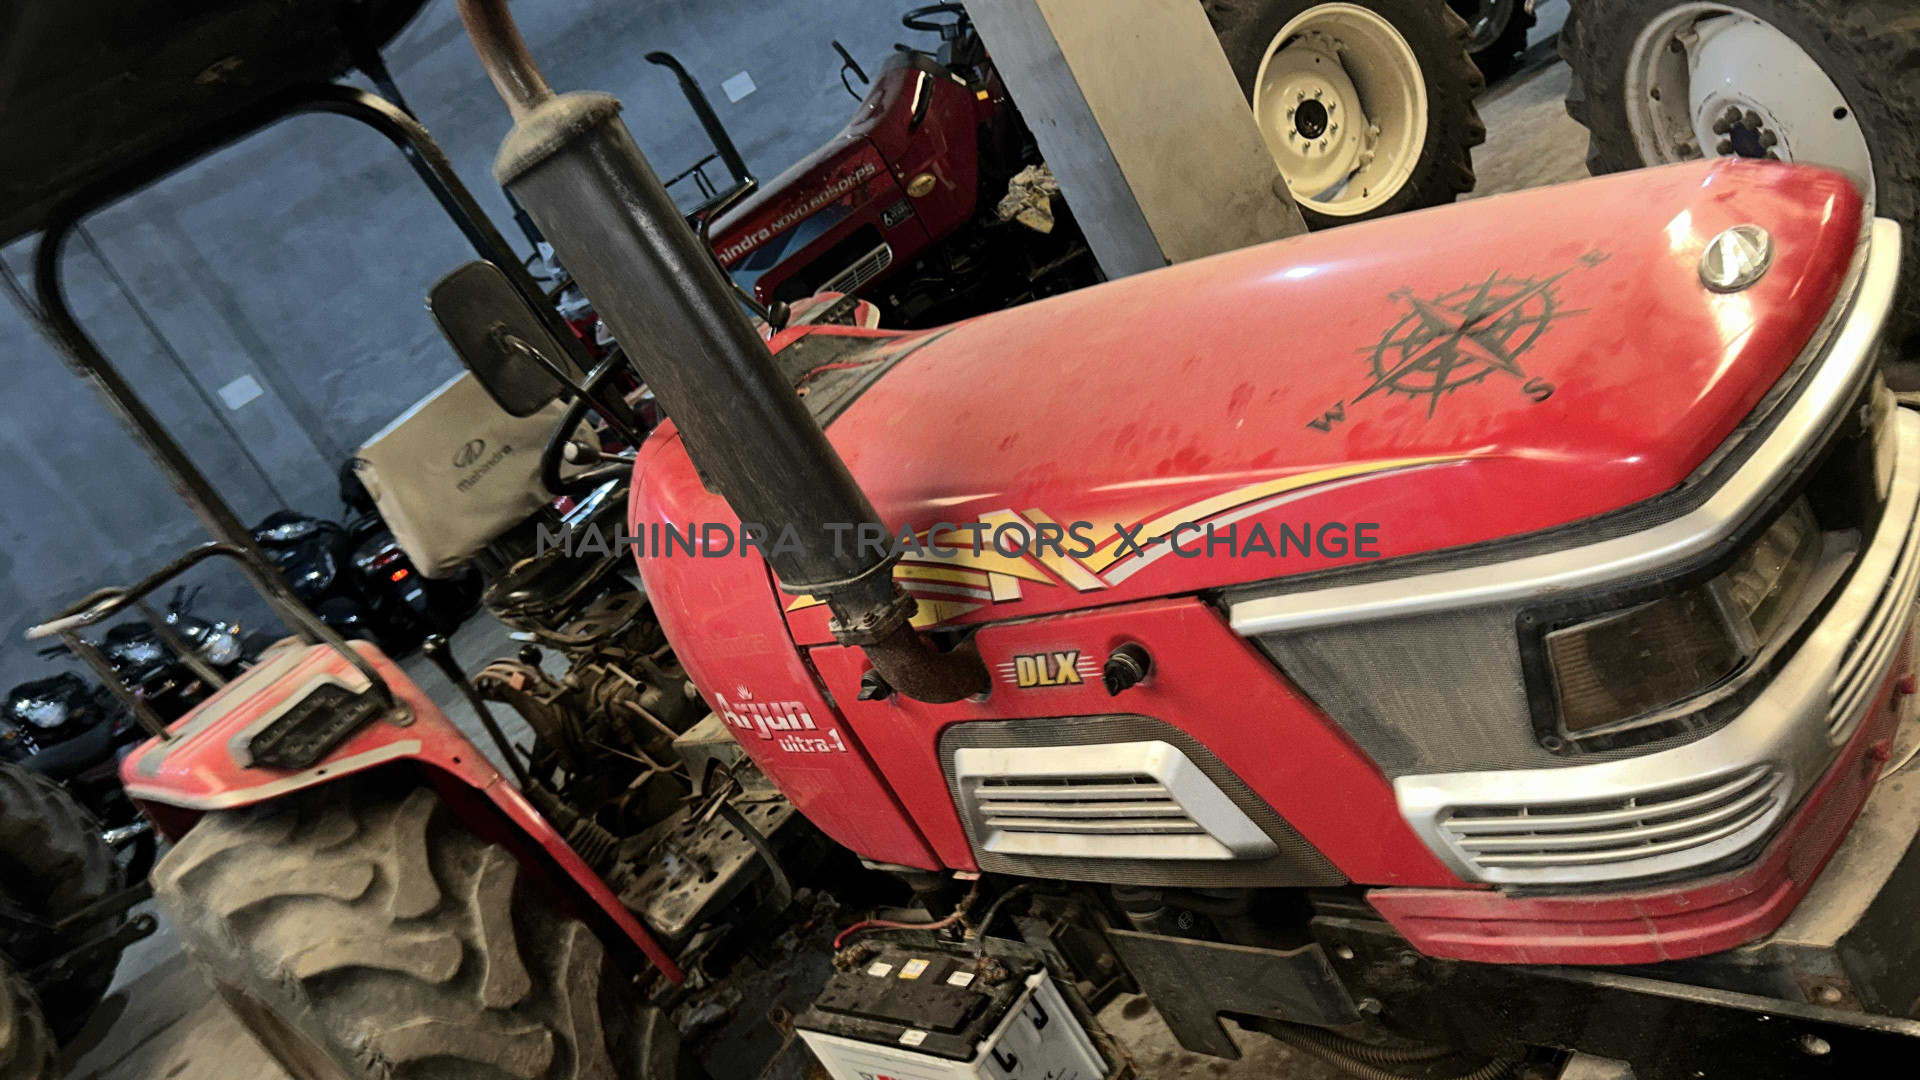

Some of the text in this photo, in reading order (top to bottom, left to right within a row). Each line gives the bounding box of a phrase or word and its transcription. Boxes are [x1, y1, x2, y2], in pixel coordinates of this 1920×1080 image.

[771, 204, 809, 232] NOVO
[1522, 377, 1555, 403] S
[1304, 400, 1346, 432] W
[1015, 650, 1083, 688] DLX
[716, 691, 817, 739] Arjun
[779, 728, 848, 753] ultra-1
